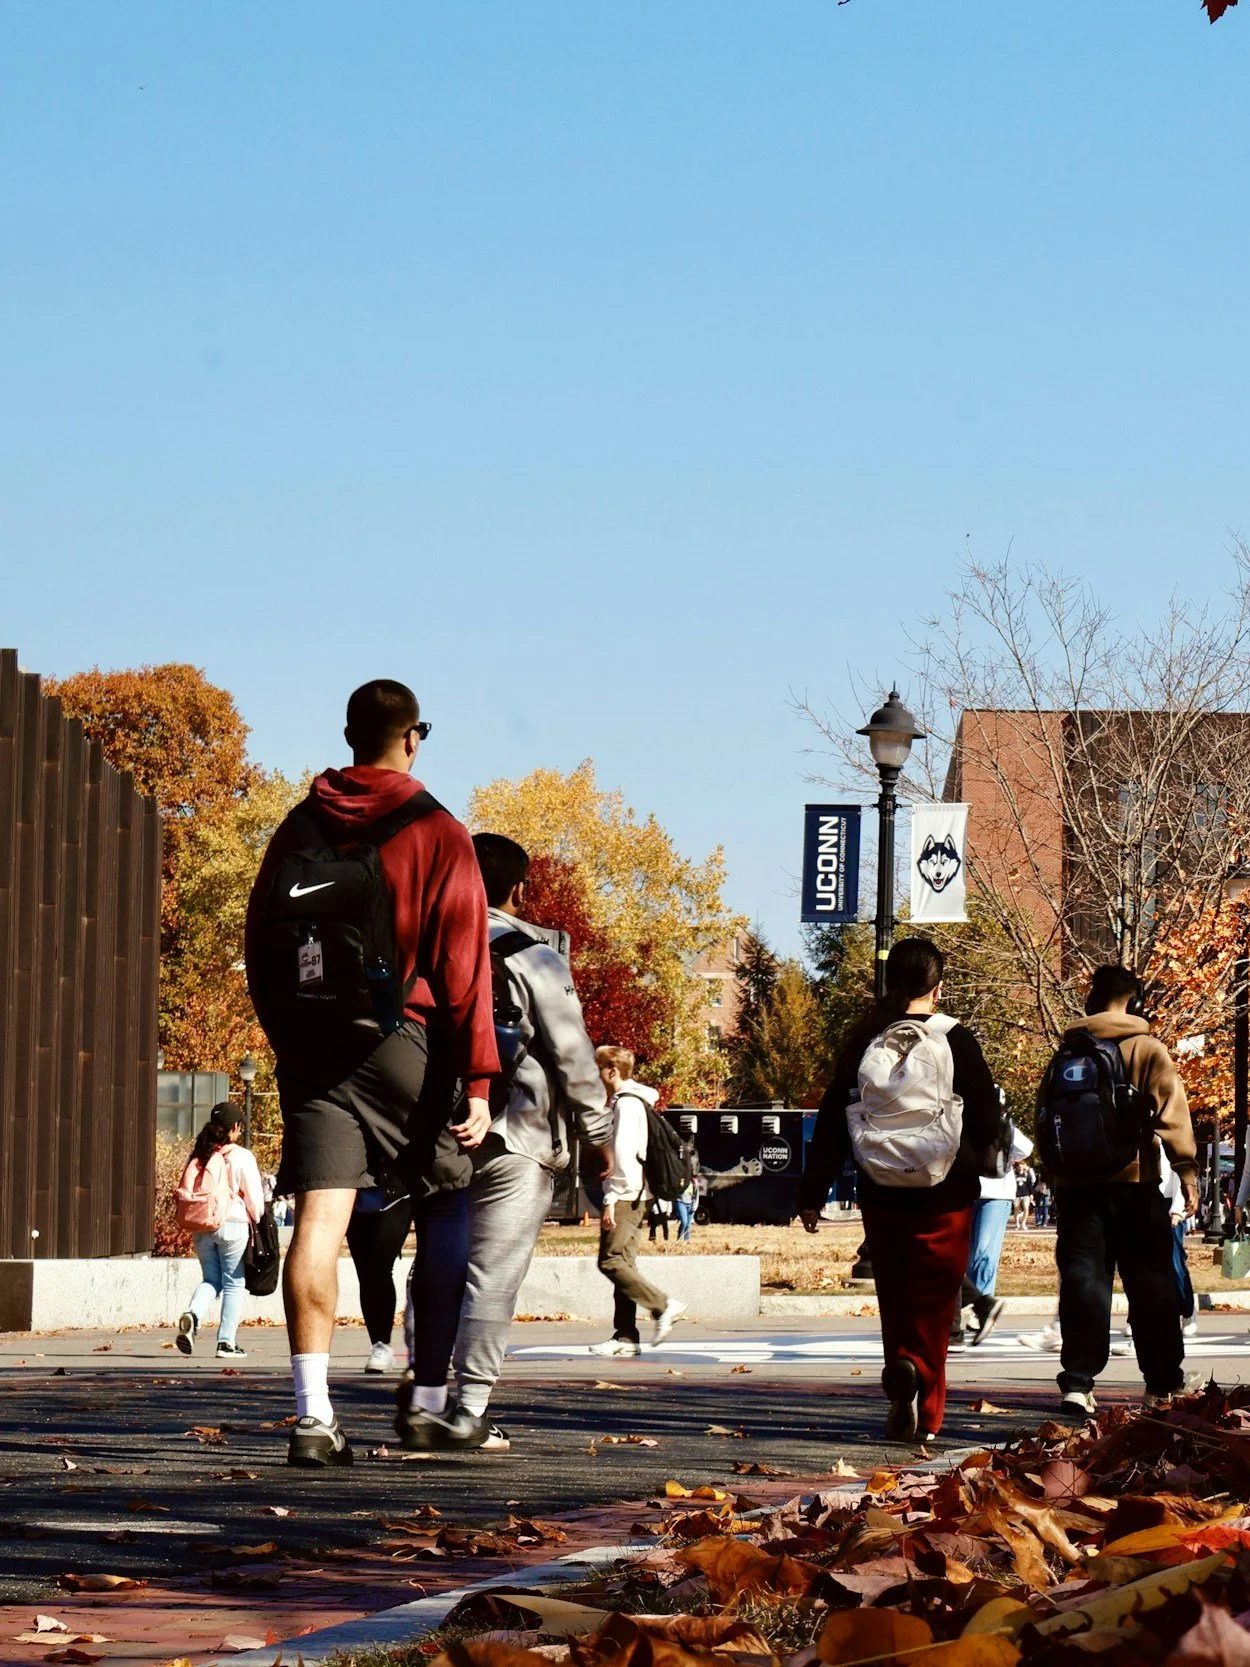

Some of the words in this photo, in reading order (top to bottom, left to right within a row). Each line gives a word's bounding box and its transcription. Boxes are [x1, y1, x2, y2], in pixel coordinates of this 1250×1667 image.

[839, 816, 847, 862] CONNECTICUT
[815, 816, 839, 911] UCONN
[839, 862, 846, 873] OF
